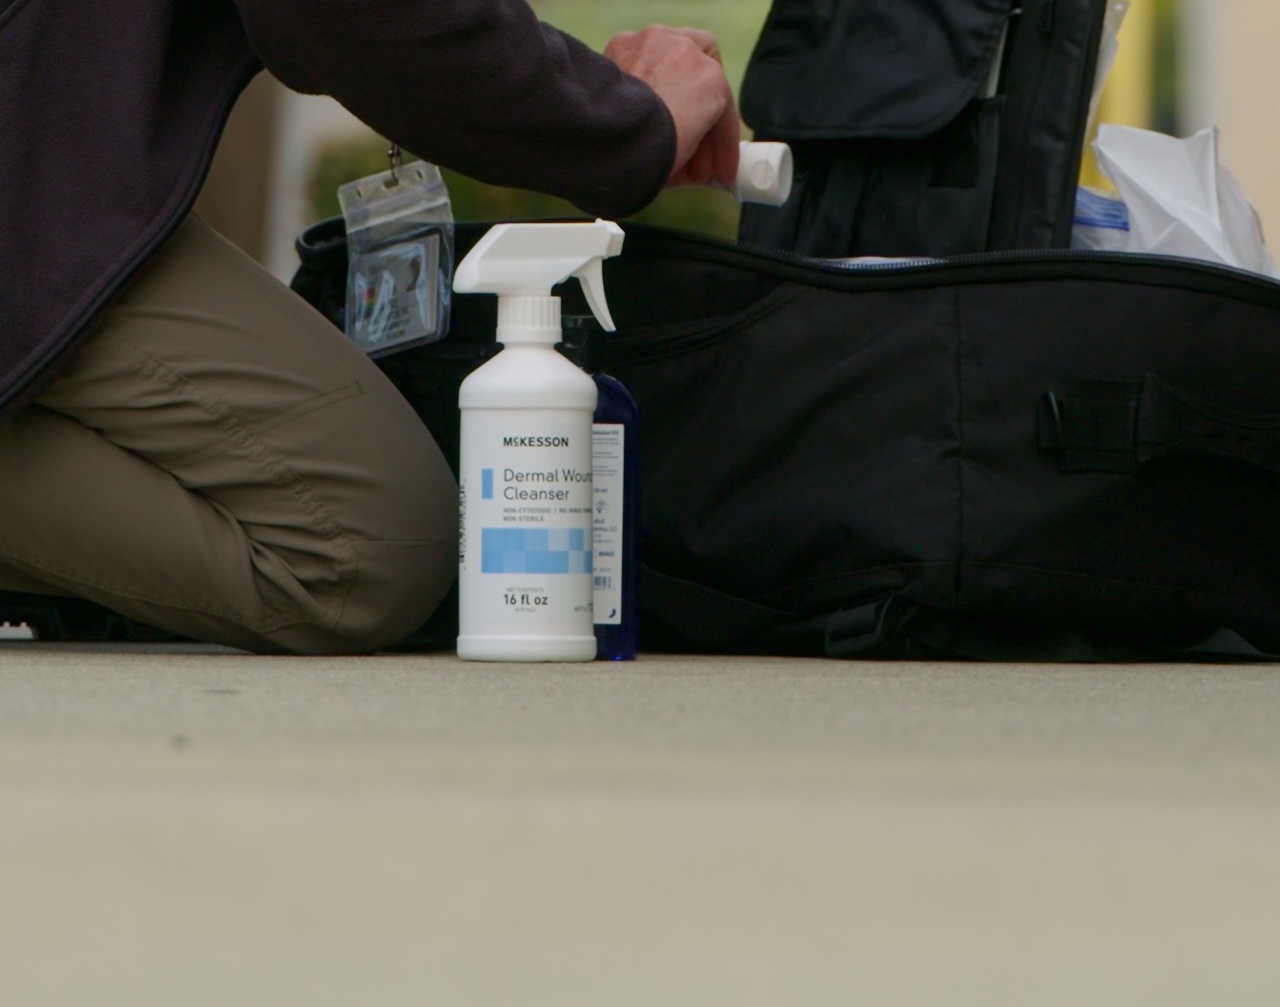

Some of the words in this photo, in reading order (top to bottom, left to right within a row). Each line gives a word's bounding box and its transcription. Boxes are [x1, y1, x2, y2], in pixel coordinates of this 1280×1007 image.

[504, 468, 558, 482] Dermal
[562, 468, 593, 482] Woun
[503, 486, 570, 500] Cleanser
[504, 594, 517, 605] 16
[521, 594, 530, 605] fl
[534, 596, 548, 605] oz
